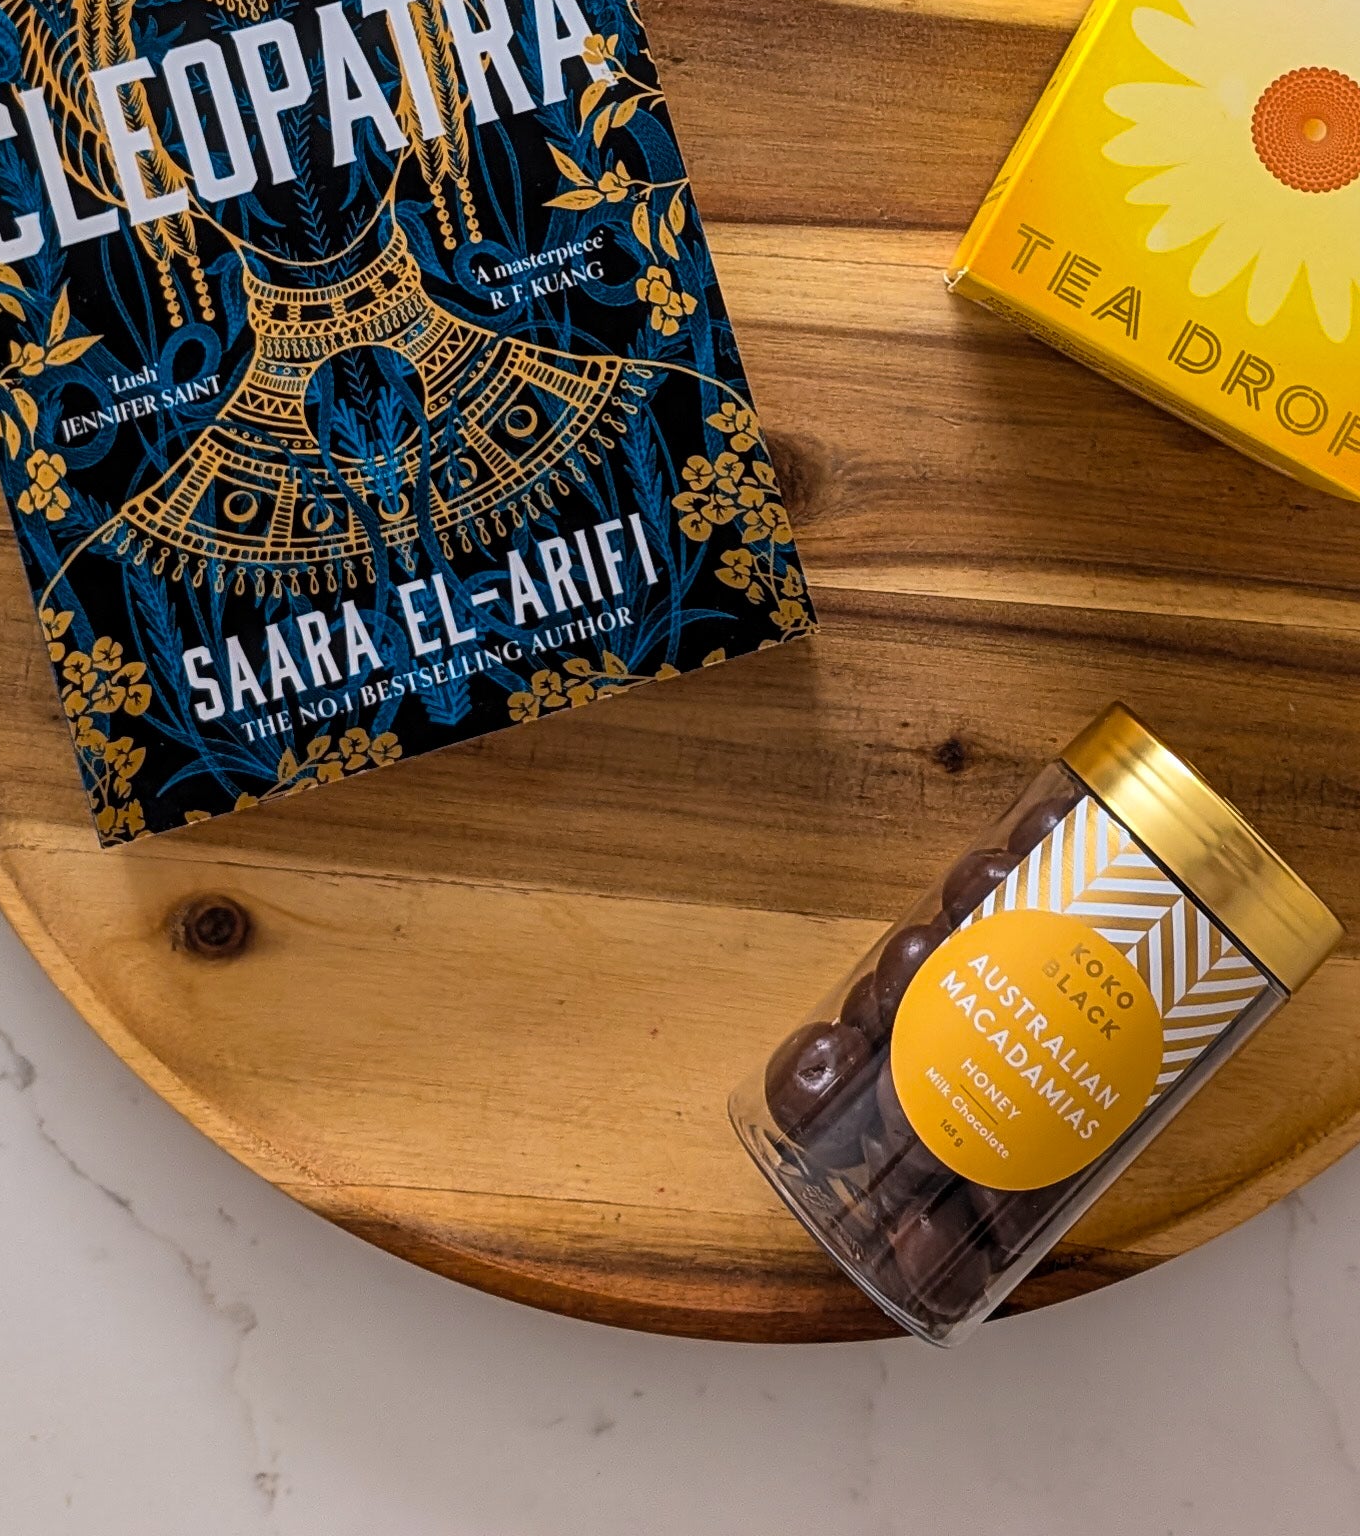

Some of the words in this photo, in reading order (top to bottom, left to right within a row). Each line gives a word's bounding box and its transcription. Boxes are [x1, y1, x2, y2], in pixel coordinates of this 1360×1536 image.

[531, 261, 605, 298] KUANG
[1011, 222, 1142, 340] TEA
[61, 394, 160, 444] JENNIFER
[161, 374, 221, 408] SAINT
[182, 598, 385, 723] SAARA
[397, 512, 660, 657] EL-ARIFI
[240, 713, 293, 743] THE
[298, 693, 355, 725] NO.1
[360, 640, 524, 708] BESTSELLING
[531, 606, 636, 657] AUTHOR
[1042, 959, 1121, 1041] BLACK
[1070, 942, 1134, 1010] KOKO
[939, 970, 1101, 1140] MACADAMIAS
[967, 953, 1120, 1111] AUSTRALIAN
[924, 1066, 952, 1099] Milk
[950, 1095, 1011, 1160] Chocolate
[940, 1118, 958, 1139] 165
[960, 1057, 1022, 1121] HONEY
